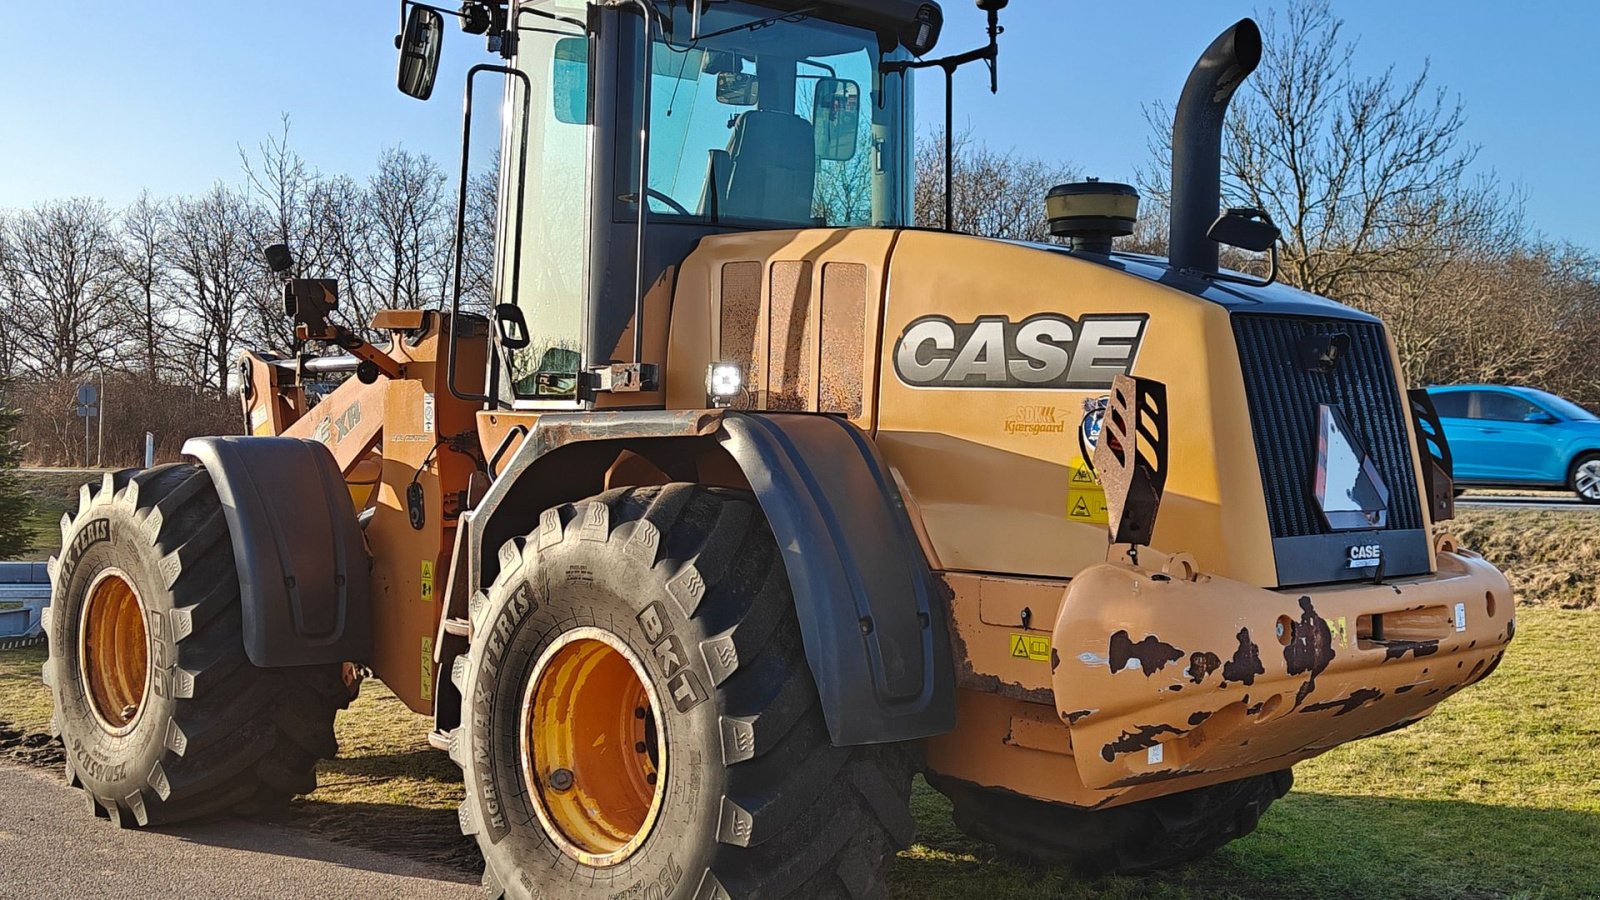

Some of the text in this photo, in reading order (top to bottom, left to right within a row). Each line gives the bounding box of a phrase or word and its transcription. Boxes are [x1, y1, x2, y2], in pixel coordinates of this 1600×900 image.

[897, 319, 1142, 383] CASE
[1004, 420, 1065, 436] Kjærsgaard
[1016, 405, 1044, 423] SDK
[73, 520, 109, 558] TERIS
[1350, 544, 1380, 559] CASE
[483, 585, 531, 678] TERIS
[638, 603, 702, 706] BKT
